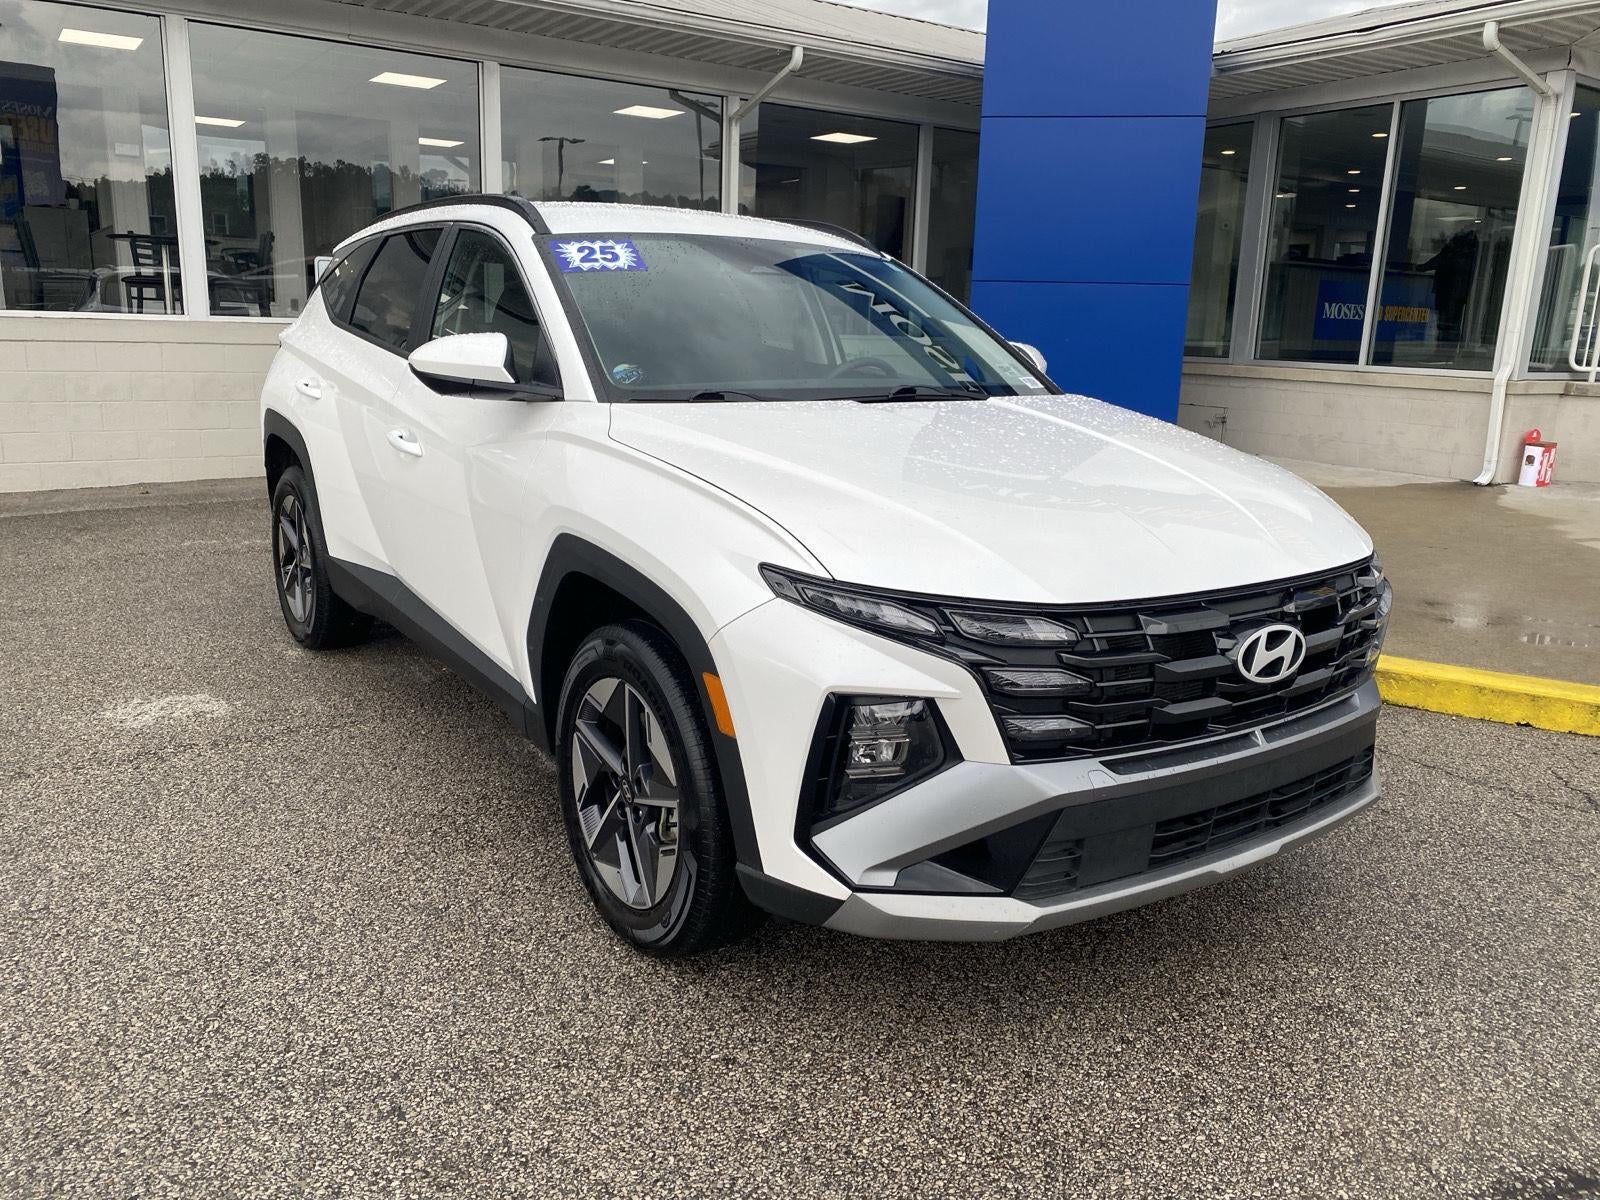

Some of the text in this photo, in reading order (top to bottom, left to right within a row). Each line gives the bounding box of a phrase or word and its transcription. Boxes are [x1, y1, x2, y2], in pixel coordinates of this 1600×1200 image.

[576, 245, 621, 264] 25
[1322, 302, 1365, 320] MOSES
[1384, 305, 1430, 323] SUPERCENTER
